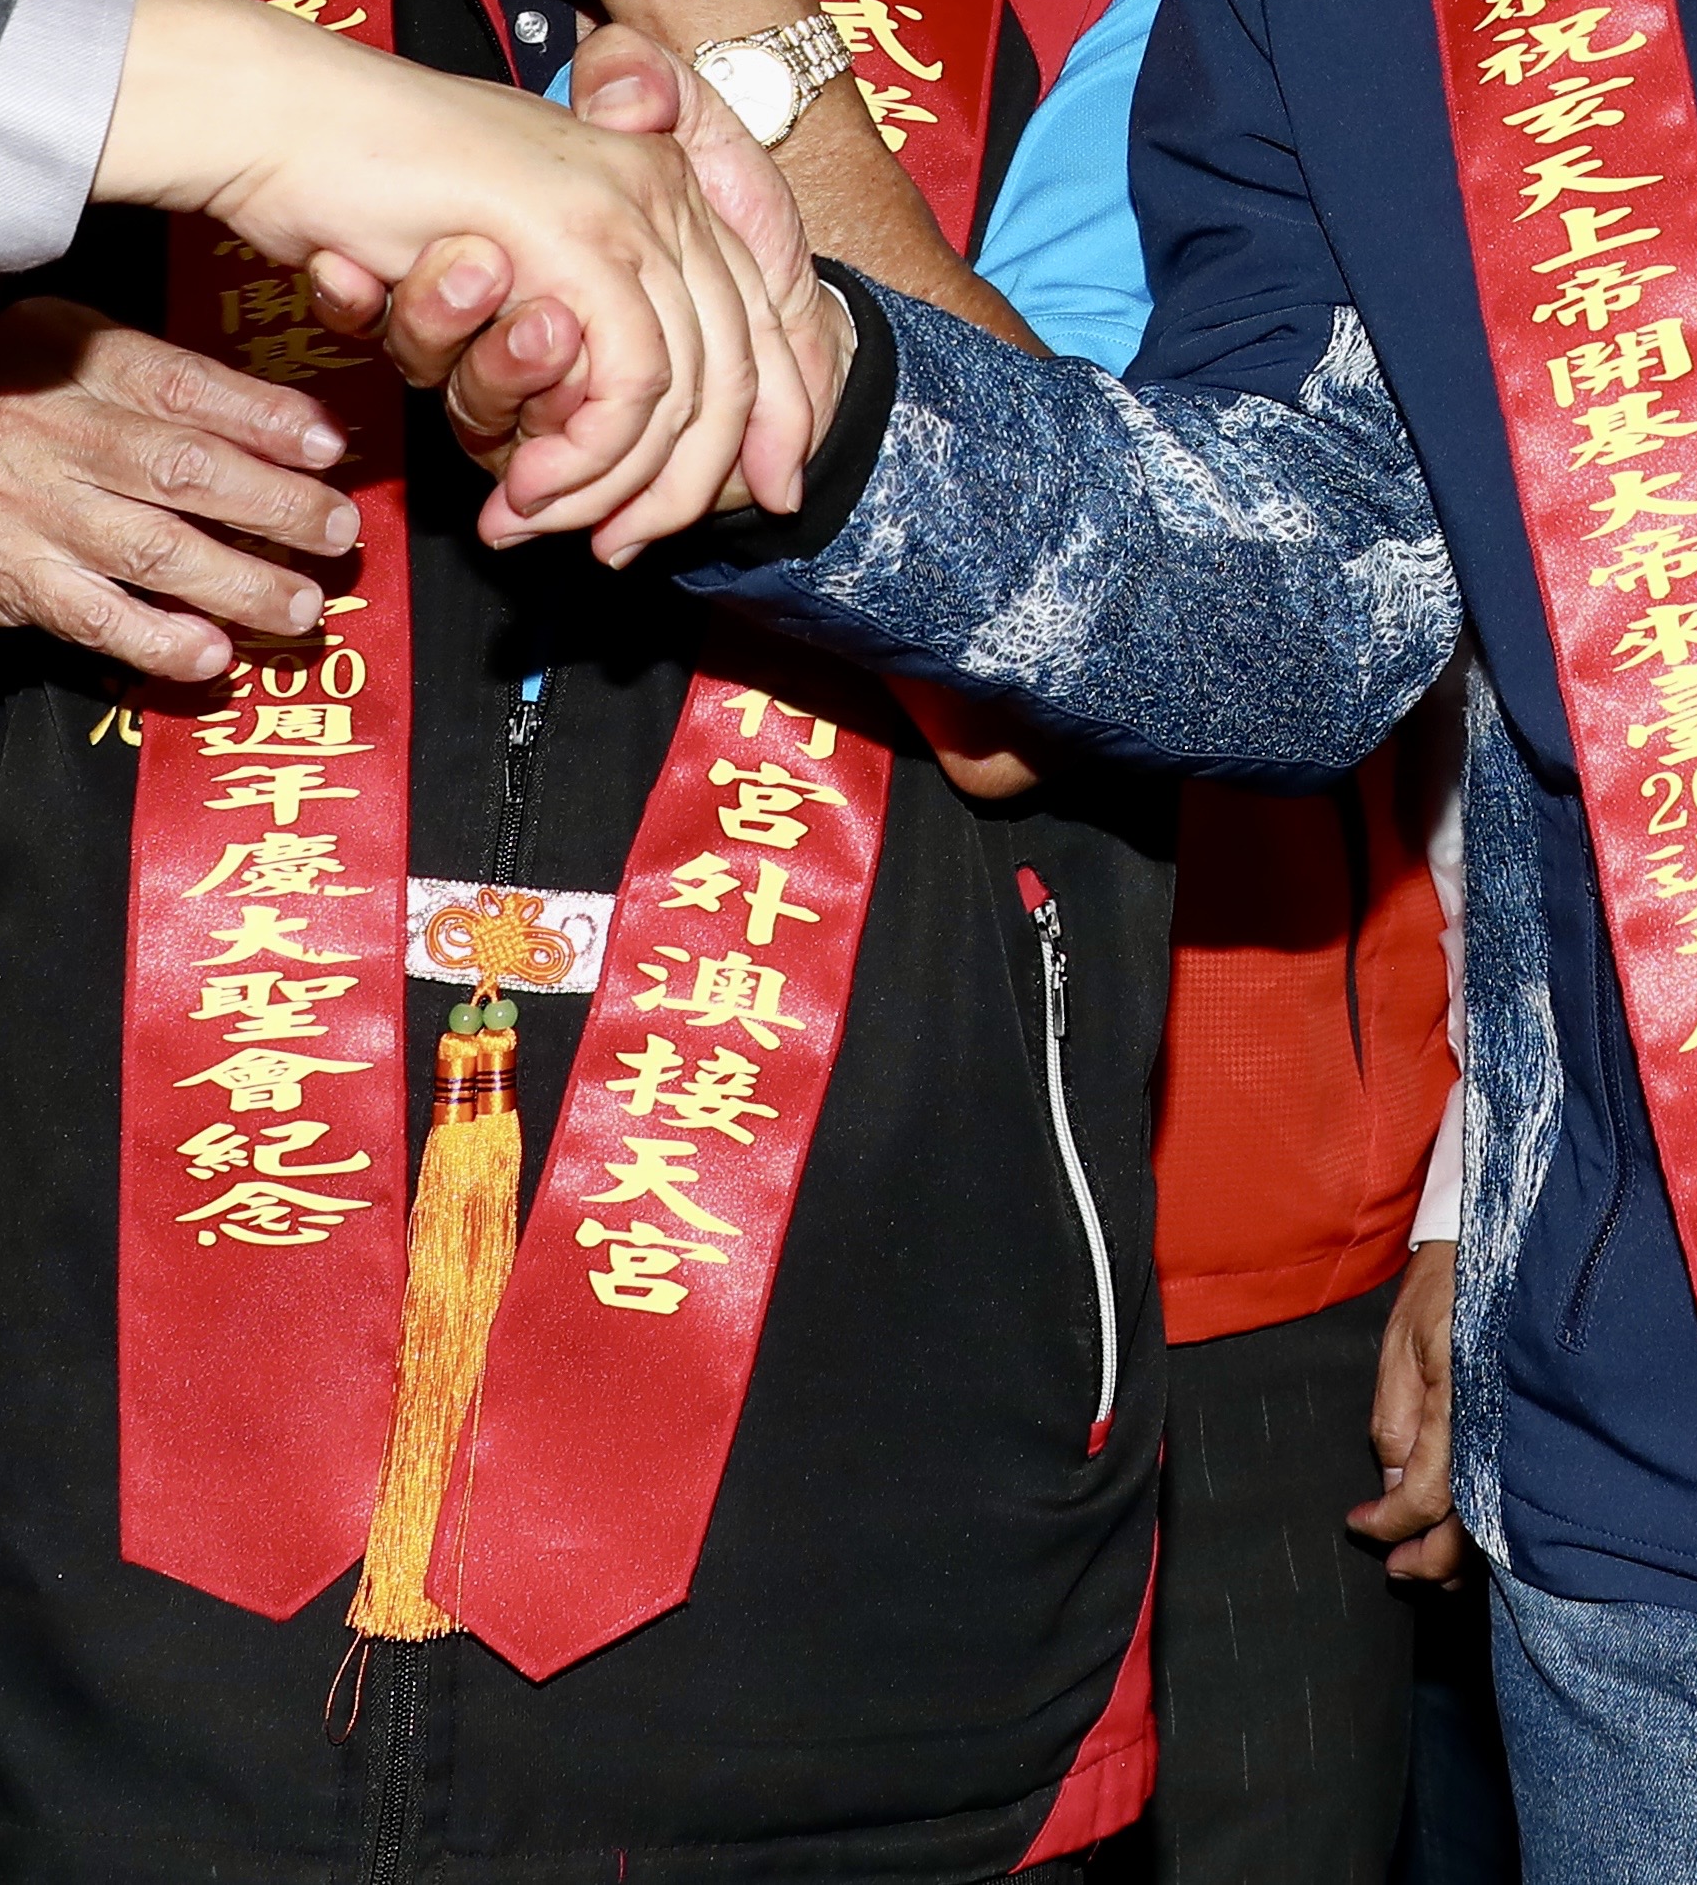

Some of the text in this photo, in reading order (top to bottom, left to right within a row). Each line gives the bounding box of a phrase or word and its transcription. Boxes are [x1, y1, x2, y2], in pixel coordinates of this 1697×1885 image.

[173, 594, 376, 1248] 200週年慶大聖會紀念
